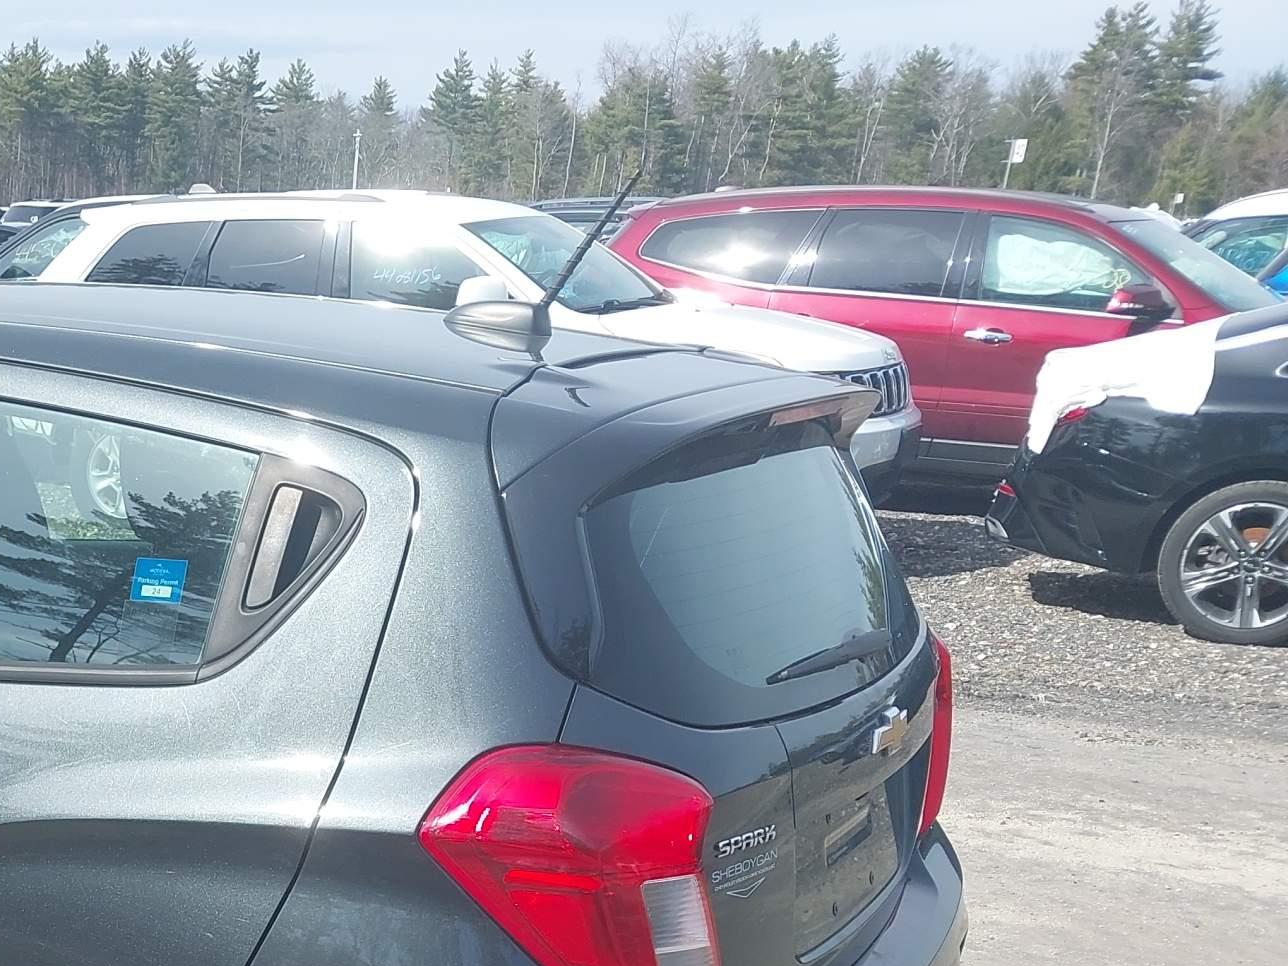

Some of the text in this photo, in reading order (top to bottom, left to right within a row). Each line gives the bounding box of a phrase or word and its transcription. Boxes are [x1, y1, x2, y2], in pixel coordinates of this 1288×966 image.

[137, 576, 179, 586] Parking Permit
[718, 824, 777, 858] SPARK
[711, 847, 778, 884] SHEBOYGAN
